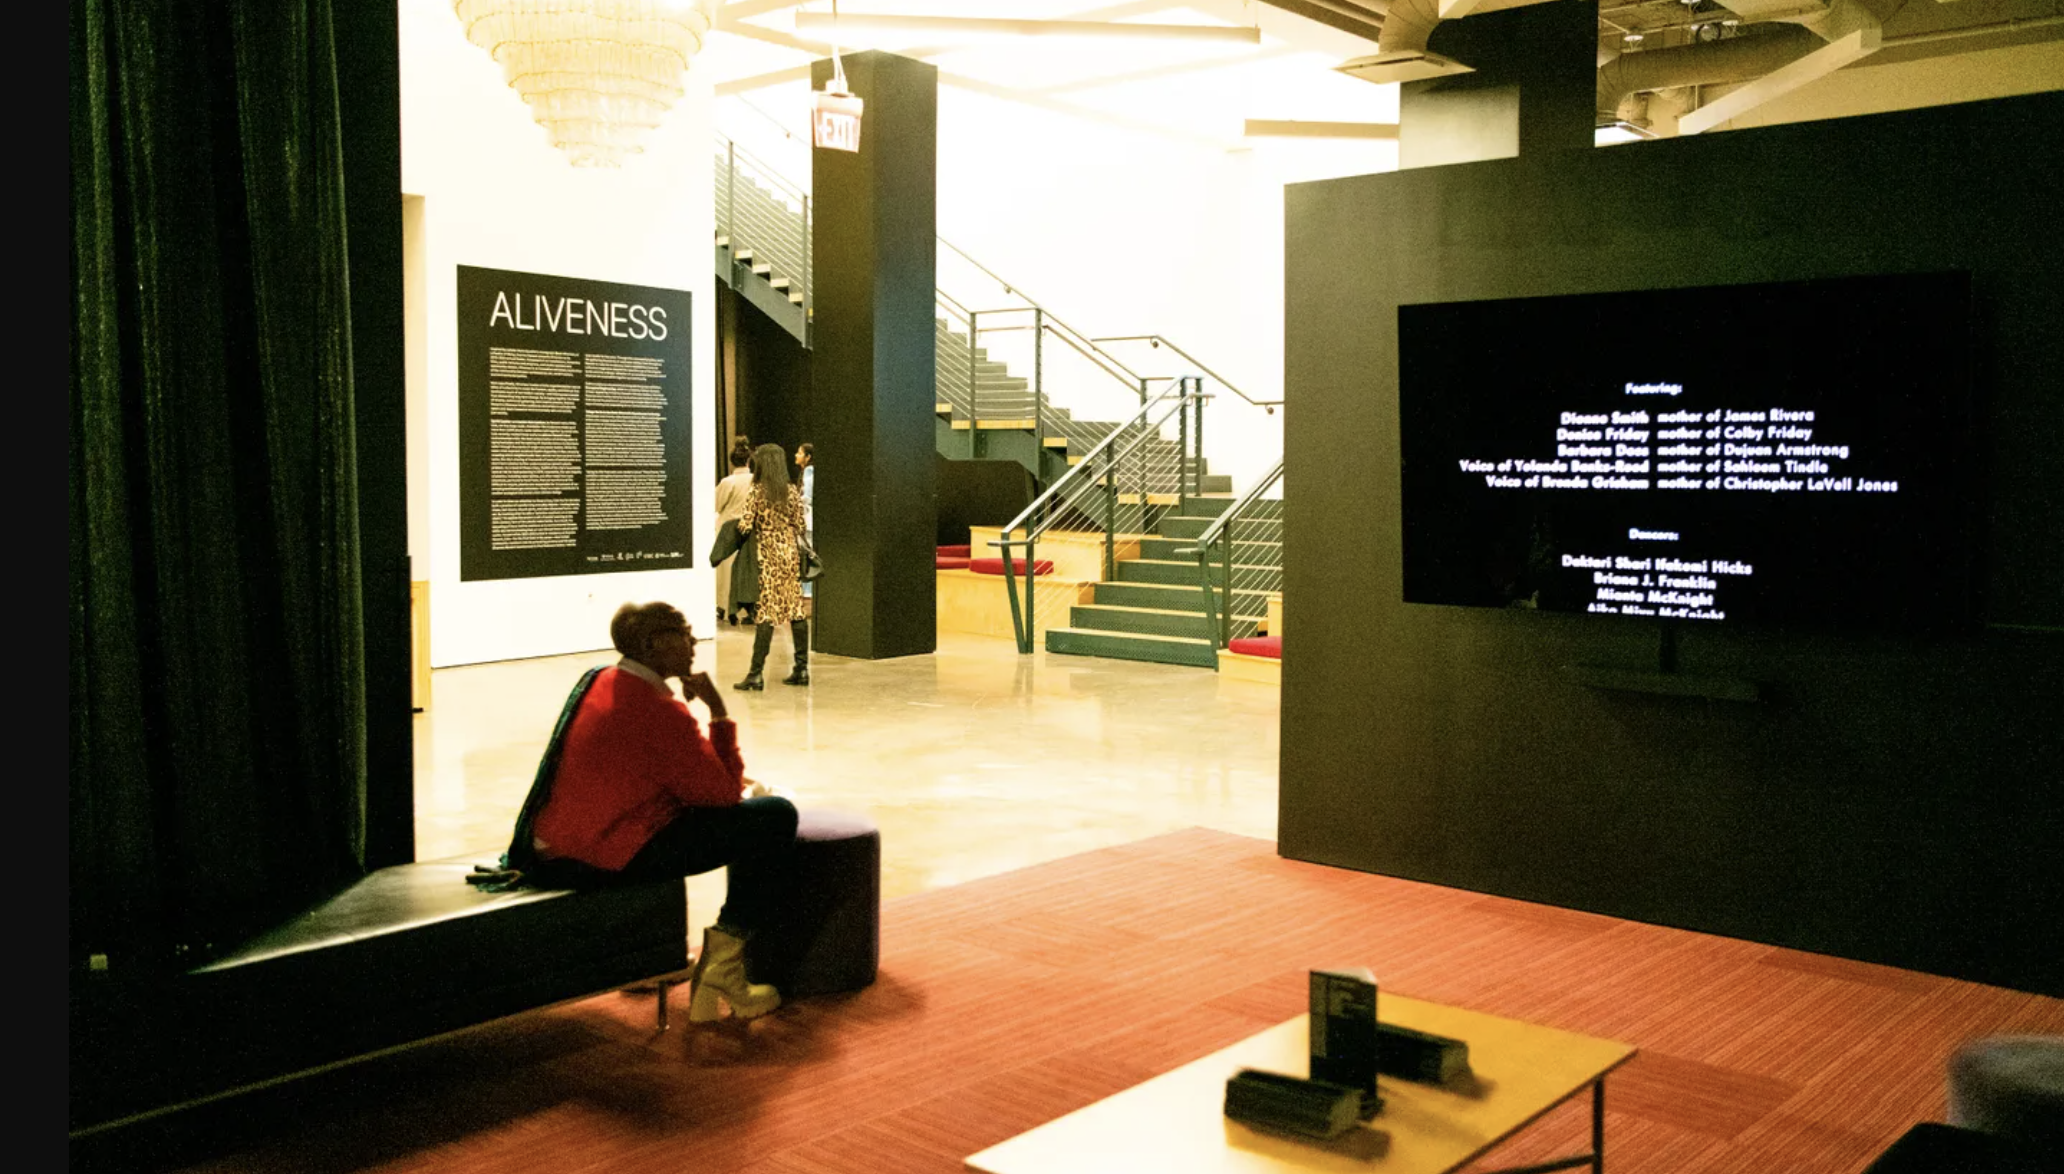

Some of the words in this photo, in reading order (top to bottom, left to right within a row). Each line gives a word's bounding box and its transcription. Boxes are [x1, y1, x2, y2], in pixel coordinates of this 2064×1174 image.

[821, 112, 858, 150] EXIT
[489, 290, 669, 341] ALIVENESS
[1625, 382, 1682, 395] Featuring:
[1612, 410, 1650, 425] Smith
[1657, 410, 1703, 423] mother
[1705, 409, 1721, 422] of
[1723, 410, 1766, 422] James
[1770, 408, 1815, 421] Rivera
[1605, 427, 1650, 443] Friday
[1657, 426, 1703, 439] mother
[1705, 426, 1721, 439] of
[1724, 426, 1764, 441] Colby
[1767, 425, 1812, 441] Friday
[1557, 443, 1613, 457] Barbara
[1657, 443, 1703, 456] mother
[1705, 443, 1721, 456] of
[1724, 443, 1772, 458] Dujuan
[1776, 443, 1849, 459] Armstrong
[1459, 460, 1495, 472] Voice
[1497, 459, 1512, 472] of
[1514, 459, 1568, 472] Yolanda
[1657, 459, 1703, 472] mother
[1705, 459, 1721, 472] of
[1784, 459, 1829, 473] Tindle
[1485, 475, 1522, 487] Voice
[1524, 475, 1540, 487] of
[1542, 475, 1589, 488] Brenda
[1657, 476, 1703, 489] mother
[1705, 476, 1721, 489] of
[1723, 476, 1804, 492] Christopher
[1856, 478, 1898, 492] Jones
[1615, 557, 1651, 570] Shari
[1712, 561, 1752, 575] Hicks
[1642, 574, 1654, 586] J.
[1658, 574, 1717, 589] Franklin
[1648, 590, 1714, 608] McKnight
